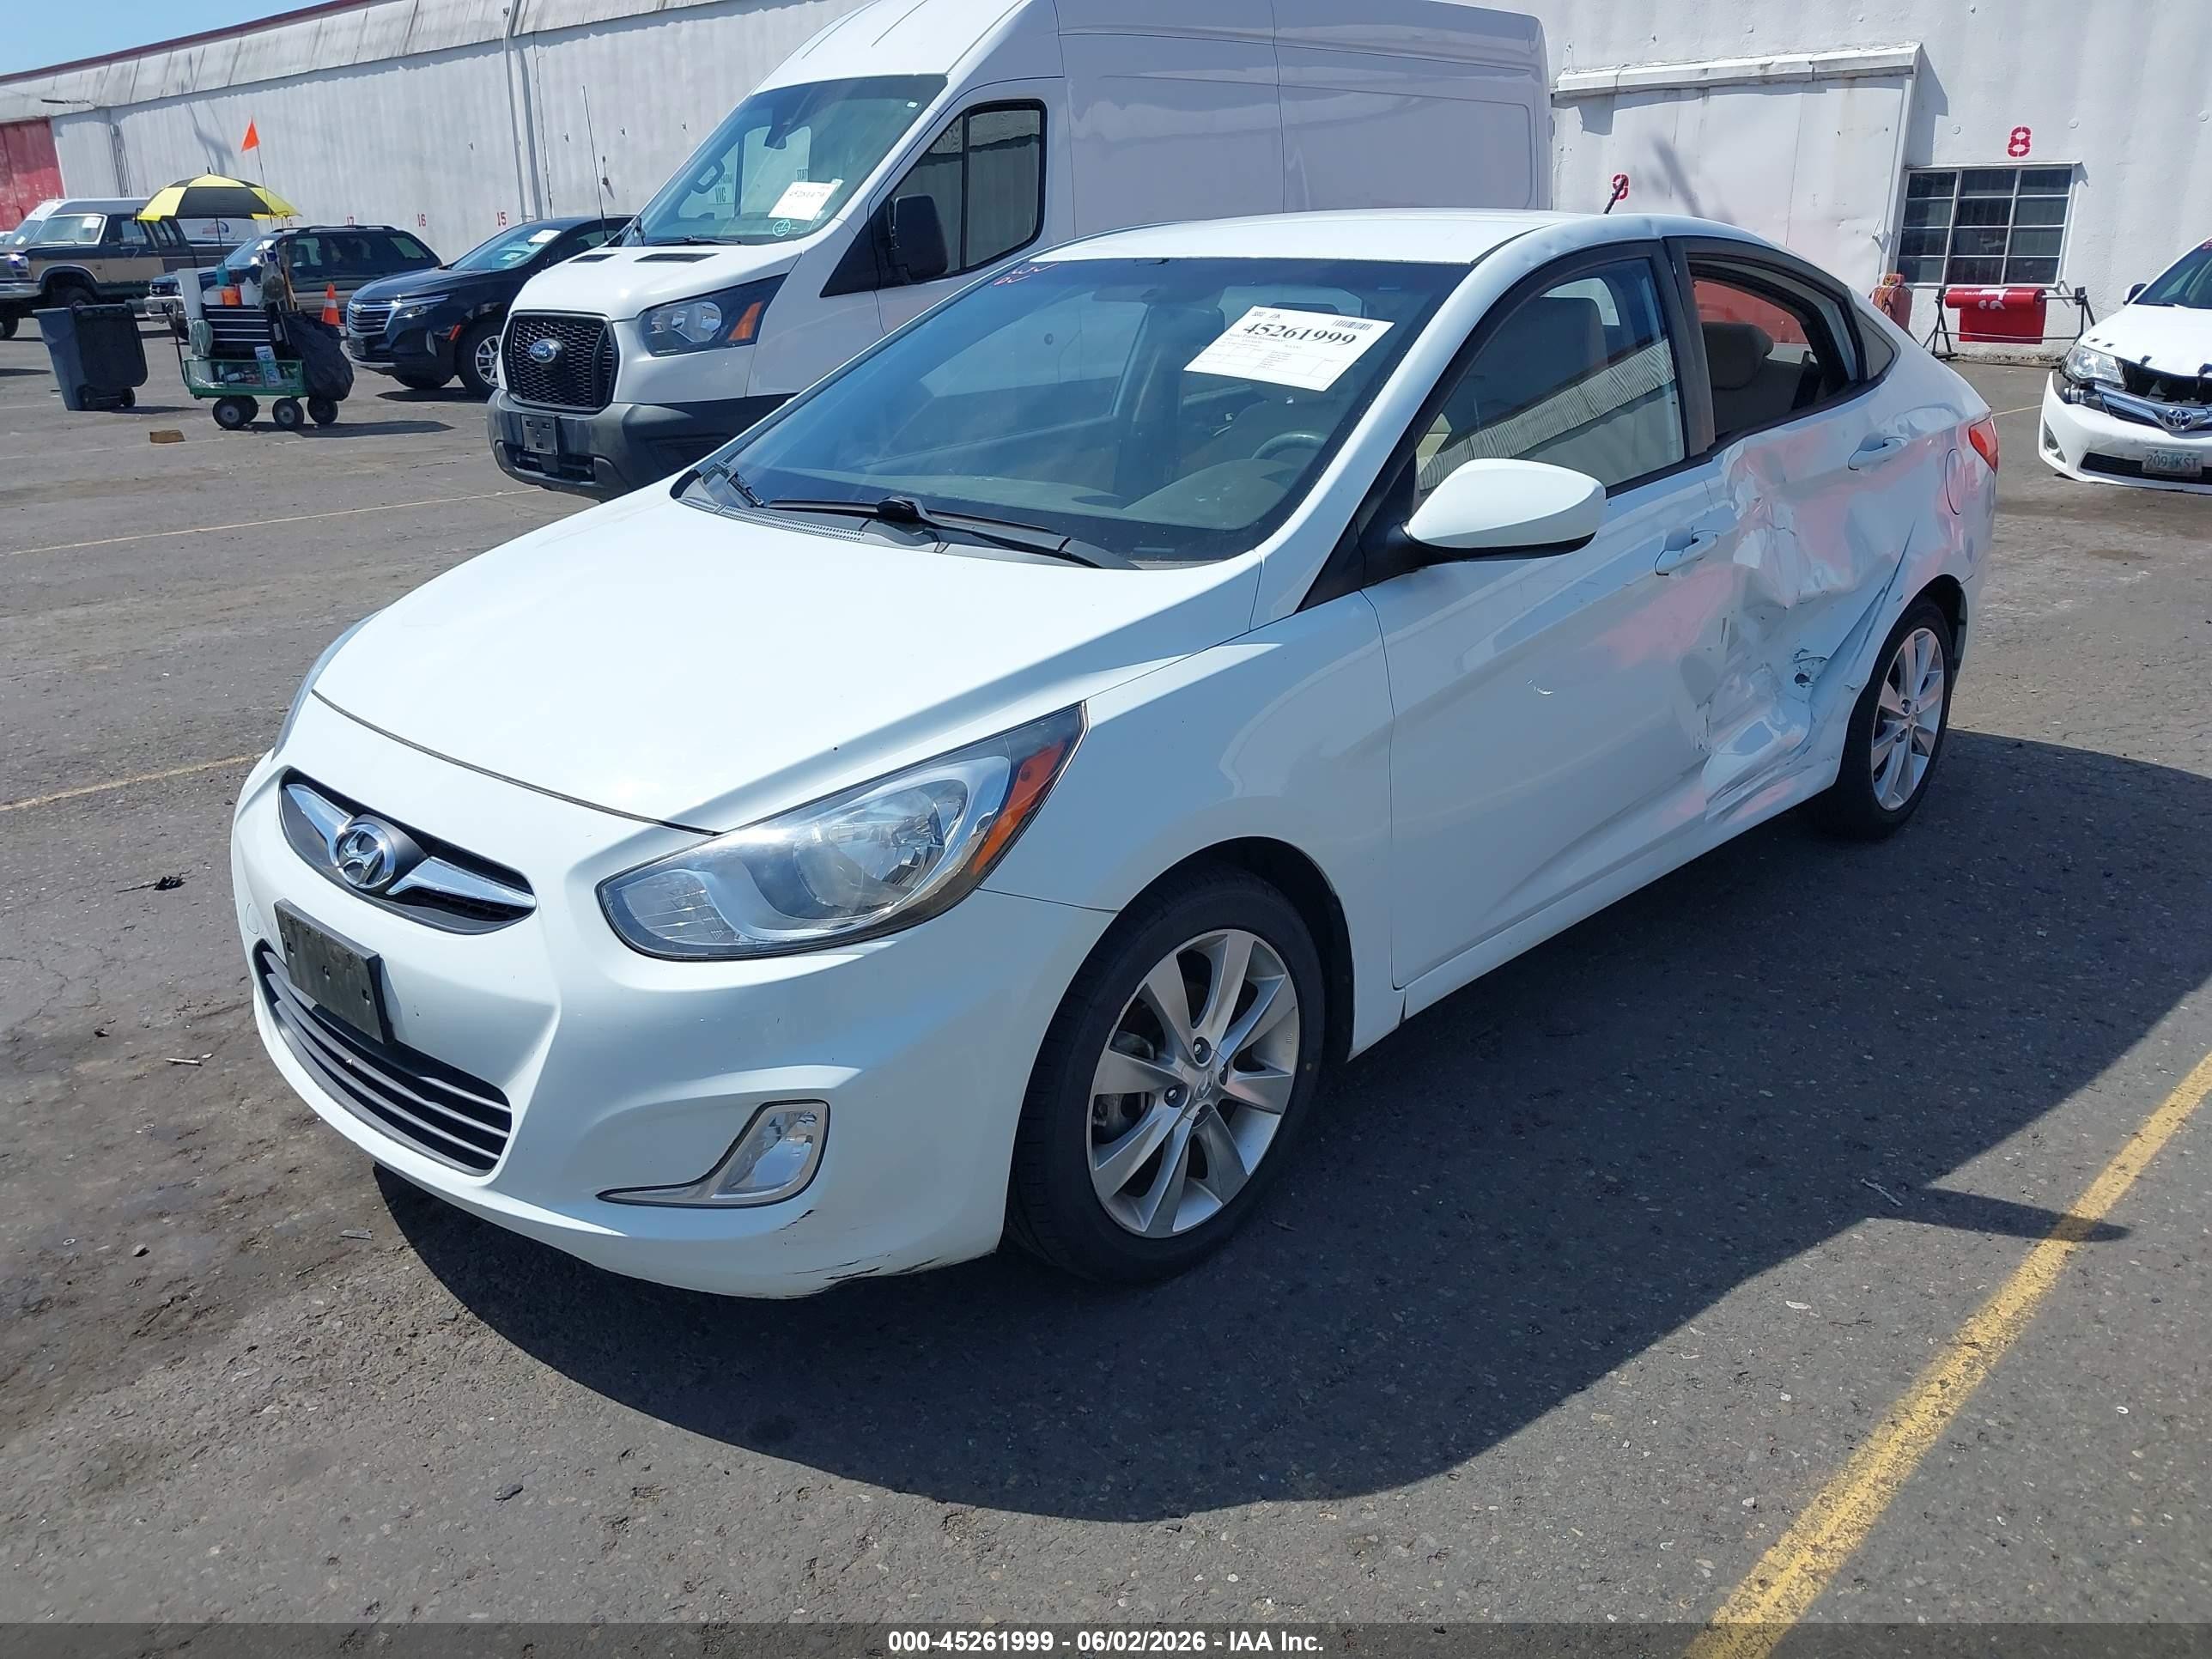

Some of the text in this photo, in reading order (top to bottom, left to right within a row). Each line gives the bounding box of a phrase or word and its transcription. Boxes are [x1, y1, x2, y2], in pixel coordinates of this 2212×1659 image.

[2008, 126, 2032, 158] 8
[1612, 173, 1630, 200] 9
[417, 214, 427, 228] 16
[496, 211, 507, 227] 15
[1243, 322, 1357, 346] 45261999
